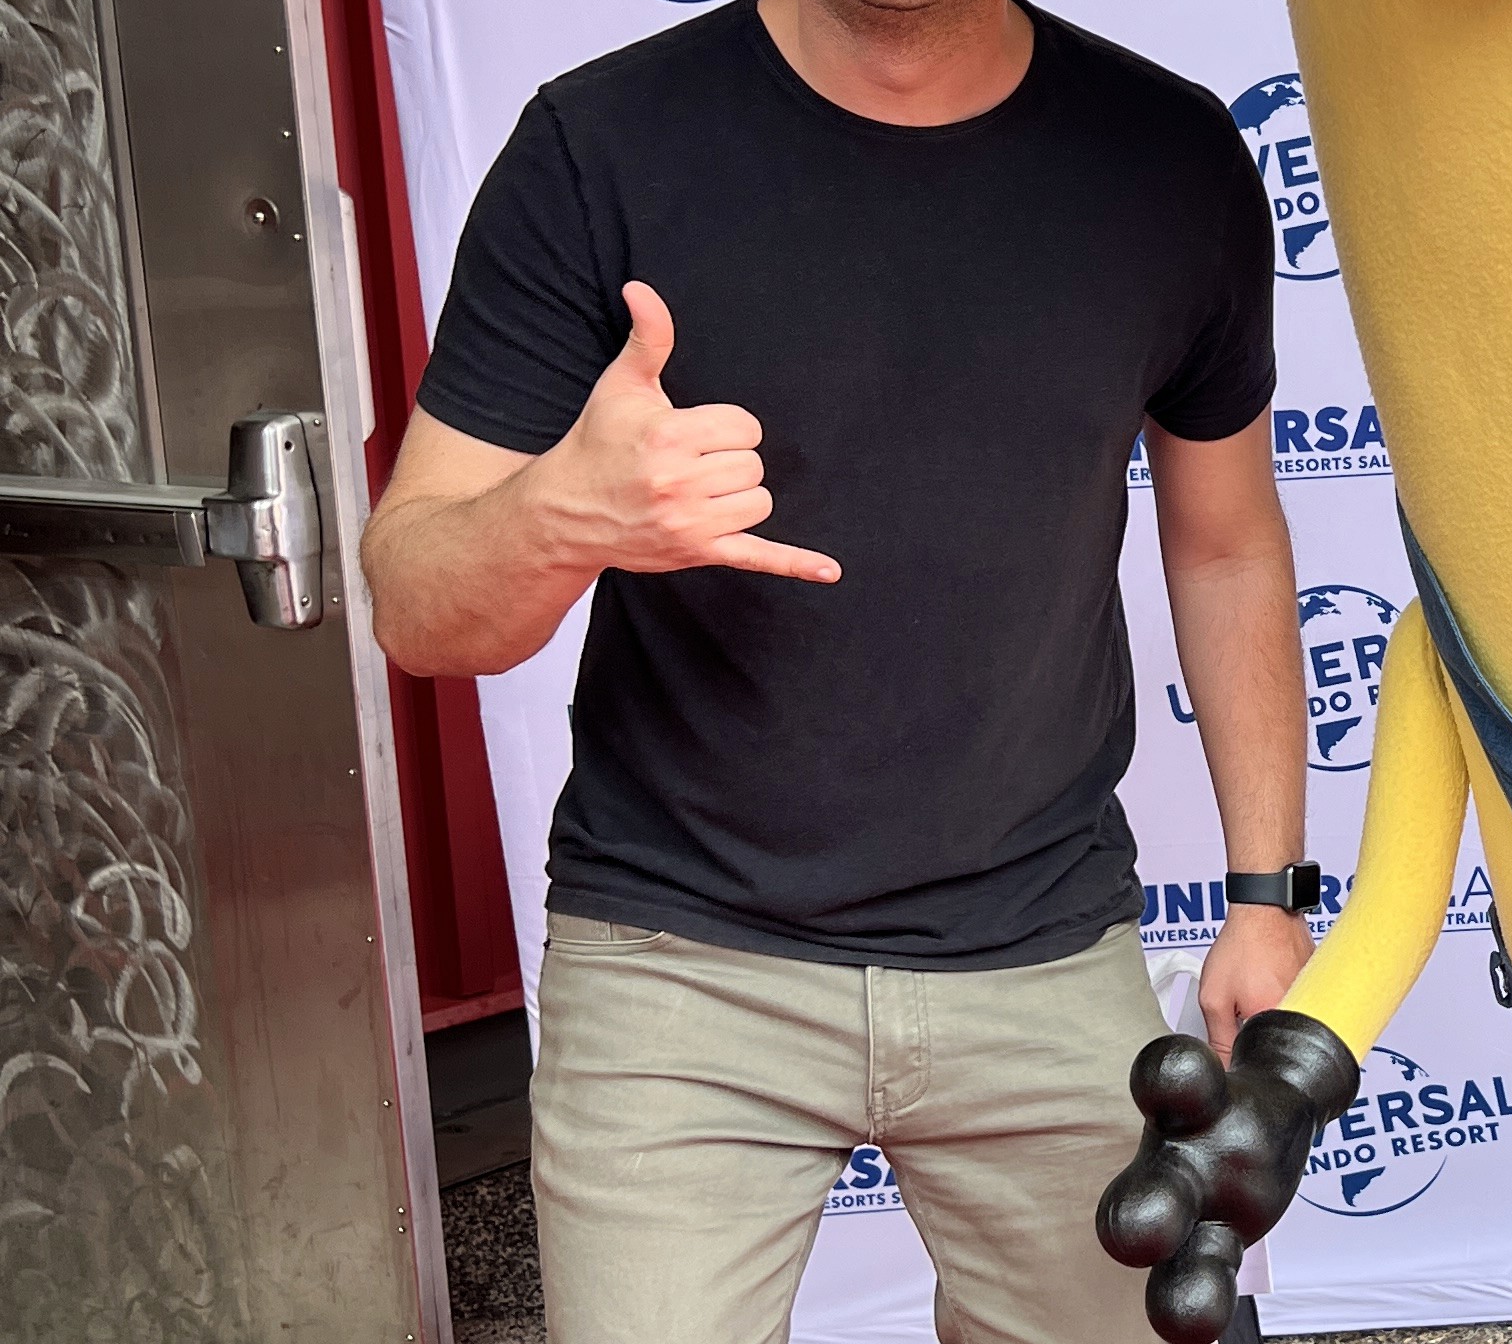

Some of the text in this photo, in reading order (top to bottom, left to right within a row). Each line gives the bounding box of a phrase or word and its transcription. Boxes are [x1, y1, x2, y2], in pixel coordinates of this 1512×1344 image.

[1274, 457, 1351, 474] RESORTS
[1446, 911, 1490, 925] TRAI
[1302, 1122, 1500, 1176] NDO RESORT
